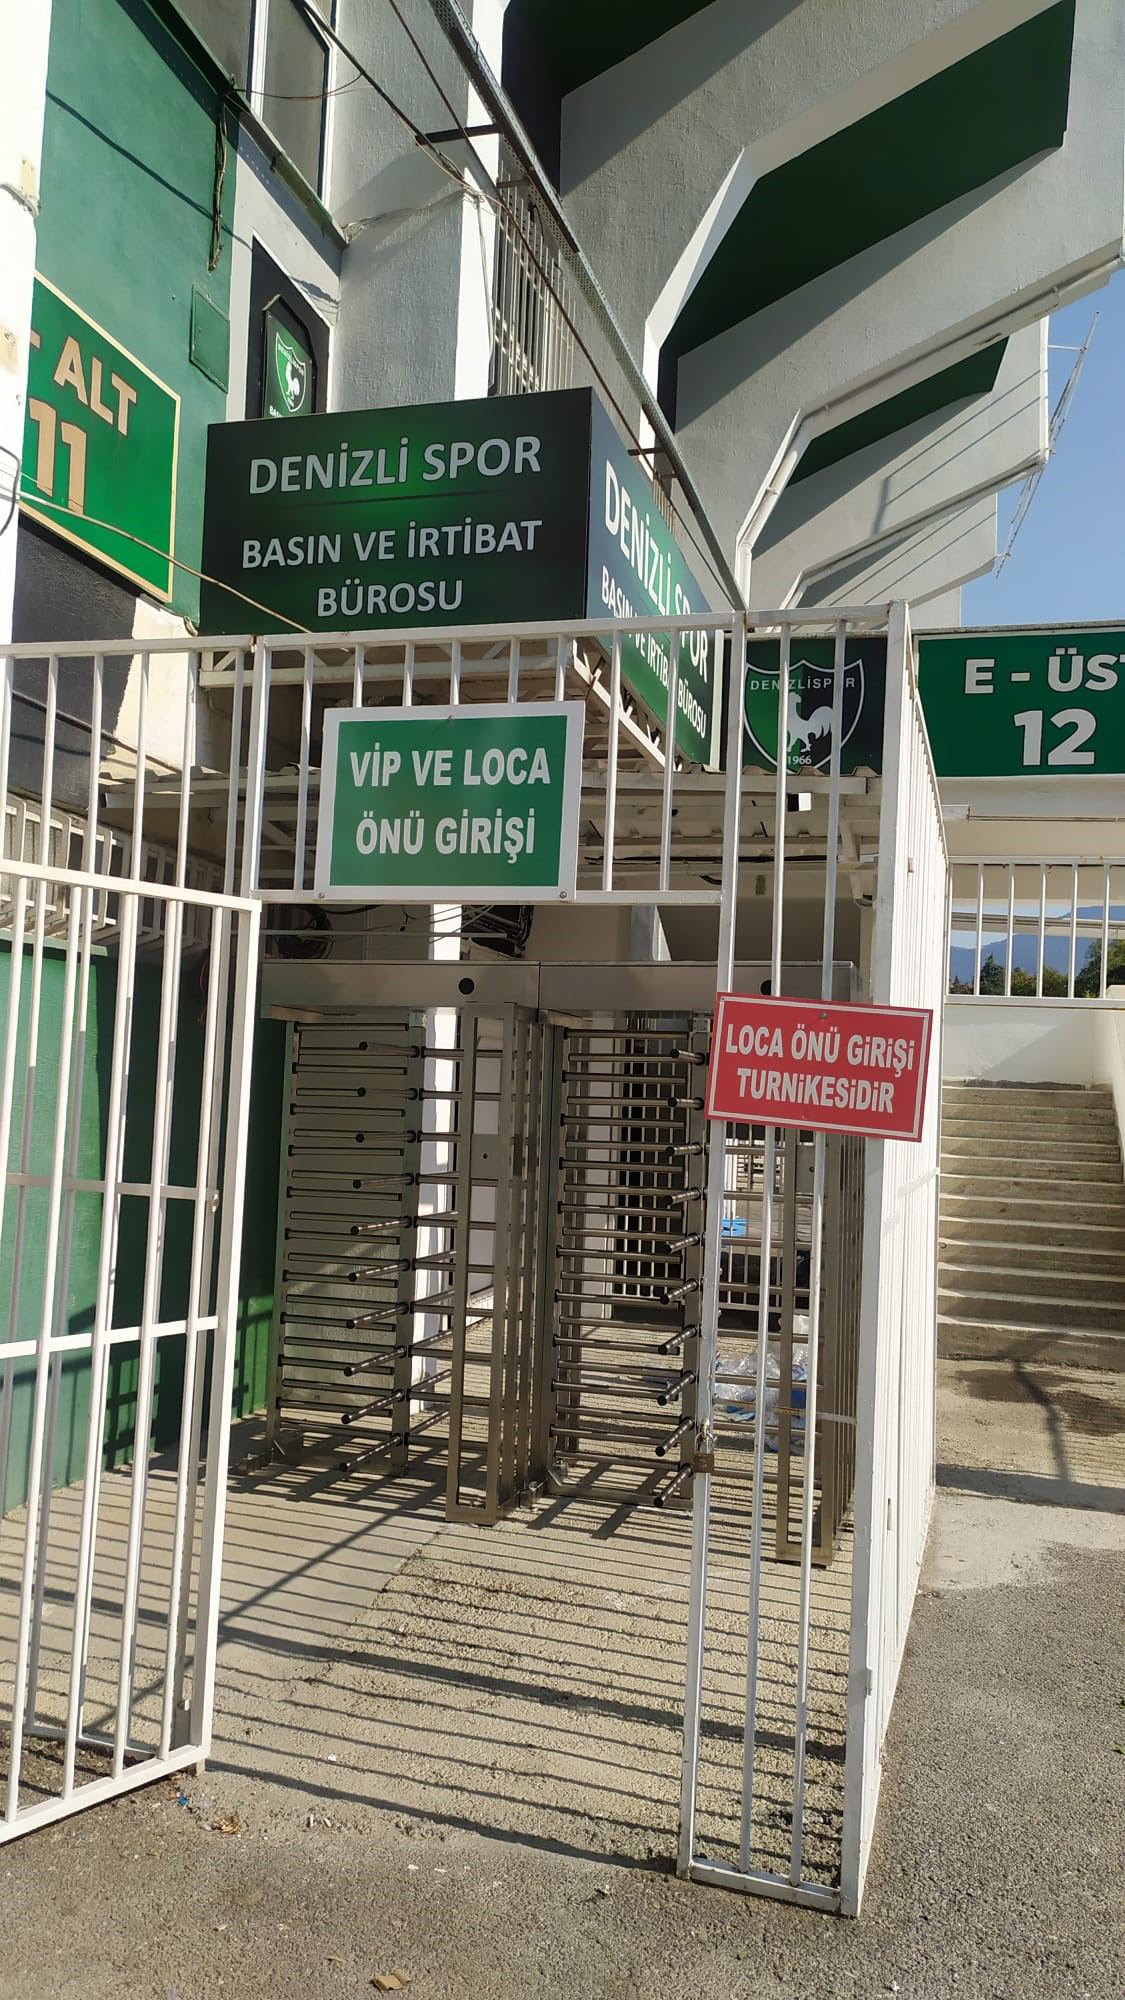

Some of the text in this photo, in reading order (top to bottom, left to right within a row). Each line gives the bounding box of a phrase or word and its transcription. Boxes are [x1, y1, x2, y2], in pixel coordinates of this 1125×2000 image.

[53, 335, 137, 437] ALT
[28, 397, 87, 516] 11
[250, 436, 541, 494] DENİZLİ SPOR
[242, 517, 543, 568] BASIN VE İRTİBAT
[605, 459, 671, 616] DENİZLİ
[317, 578, 463, 617] BÜROSU
[750, 676, 856, 691] DENZLİSPR
[965, 647, 1125, 694] E - ÜS
[677, 677, 707, 739] BÜROSU
[787, 755, 812, 765] 1966
[1013, 708, 1097, 767] 12
[350, 742, 550, 787] VİP VE LOCA
[355, 808, 535, 864] ÖNÜ GİRİŞİ
[726, 1023, 783, 1058] LOCA
[791, 1024, 840, 1063] ÖNÜ
